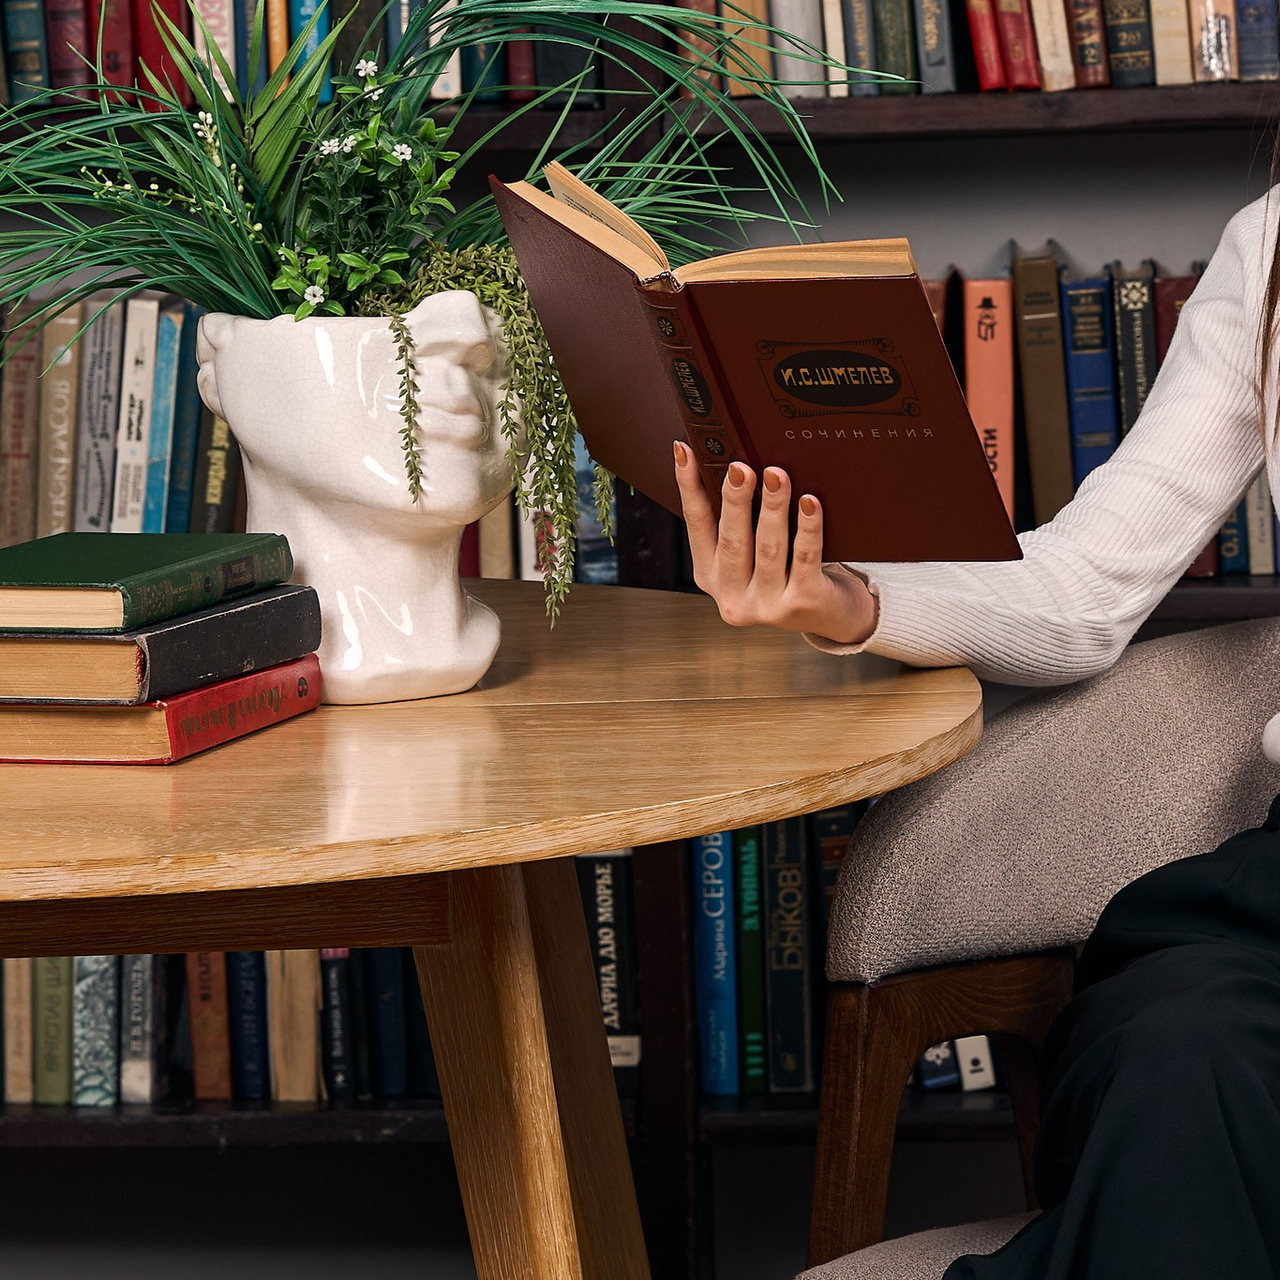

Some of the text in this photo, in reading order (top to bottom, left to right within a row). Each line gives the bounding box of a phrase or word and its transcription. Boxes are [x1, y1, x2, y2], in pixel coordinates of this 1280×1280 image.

[674, 359, 704, 414] И.С.ШМЕЛЕВ
[781, 367, 894, 386] И.С.ШМЕЛЕВ
[785, 428, 934, 439] СОЧИНЕНИЯ
[594, 863, 621, 1029] ДАФНА ДЮ МОРЬЕ
